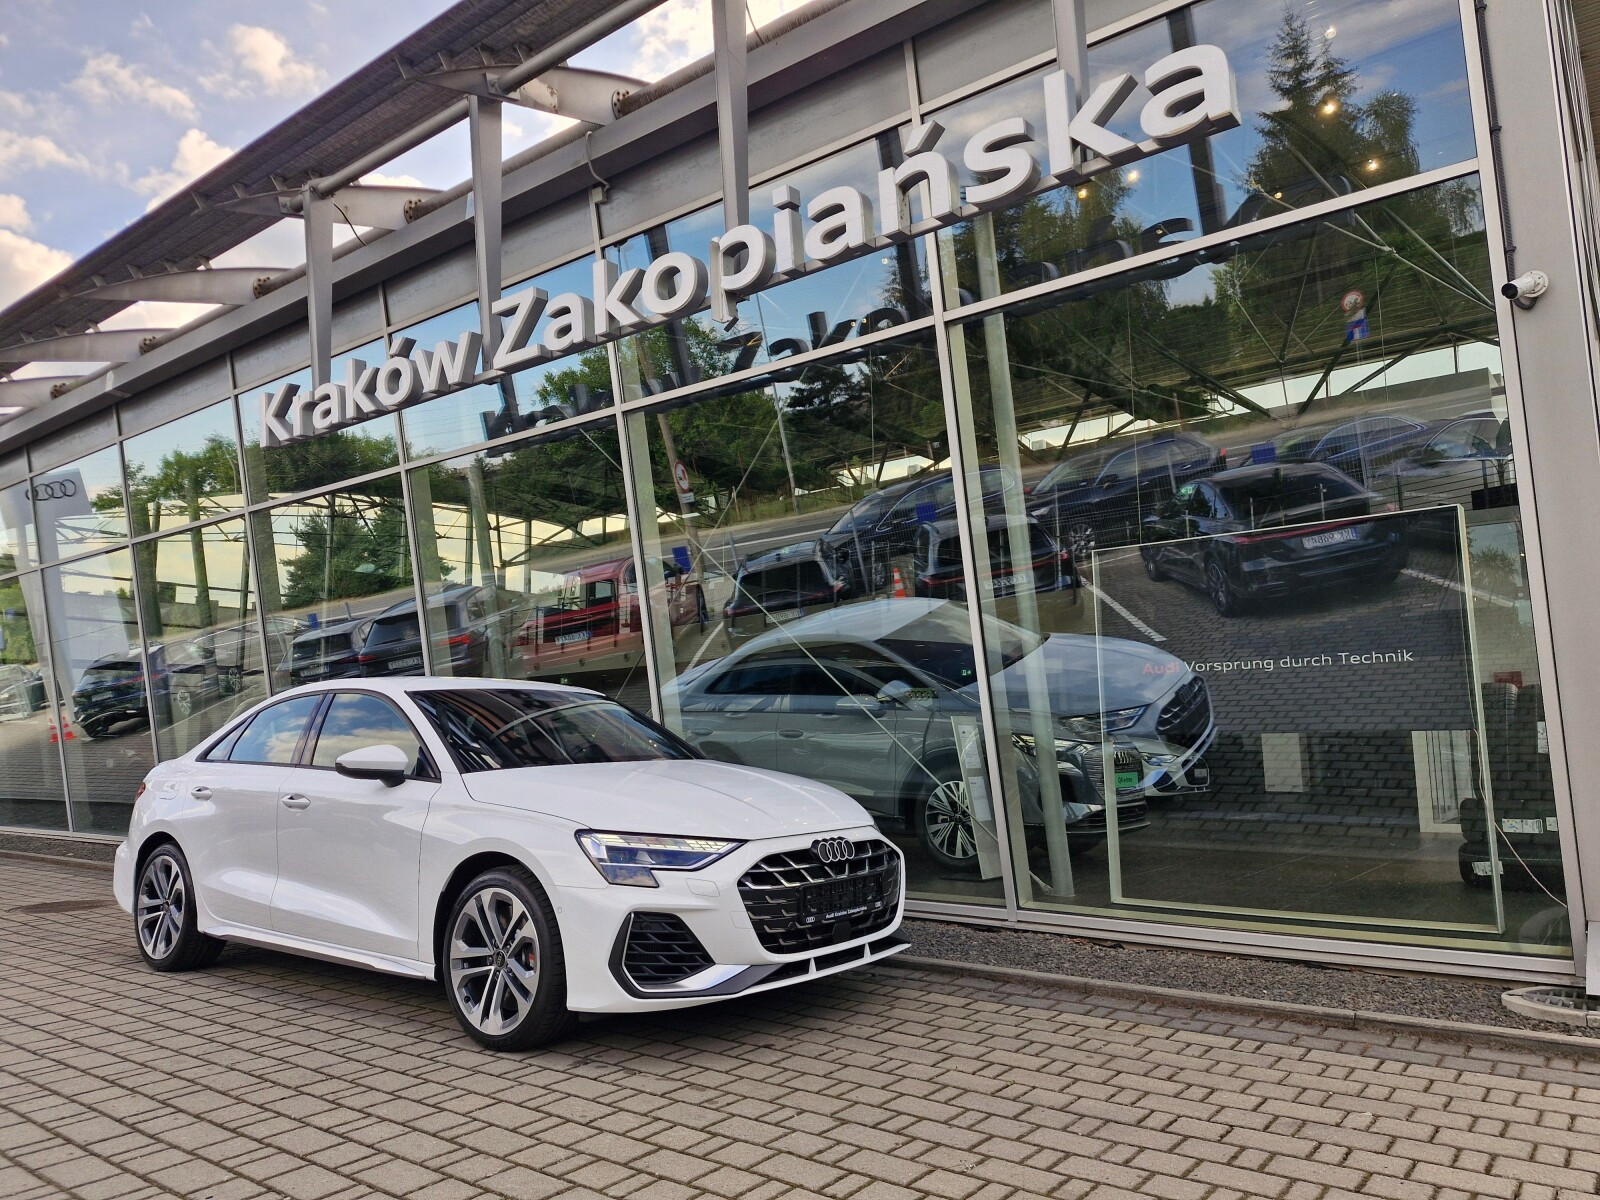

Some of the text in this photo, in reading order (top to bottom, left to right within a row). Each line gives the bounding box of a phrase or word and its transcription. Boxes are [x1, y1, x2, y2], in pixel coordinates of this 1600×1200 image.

[259, 331, 482, 447] Kraków
[491, 44, 1241, 373] Zakopiańska
[1142, 650, 1414, 674] Audi Vorsprung durch Technik
